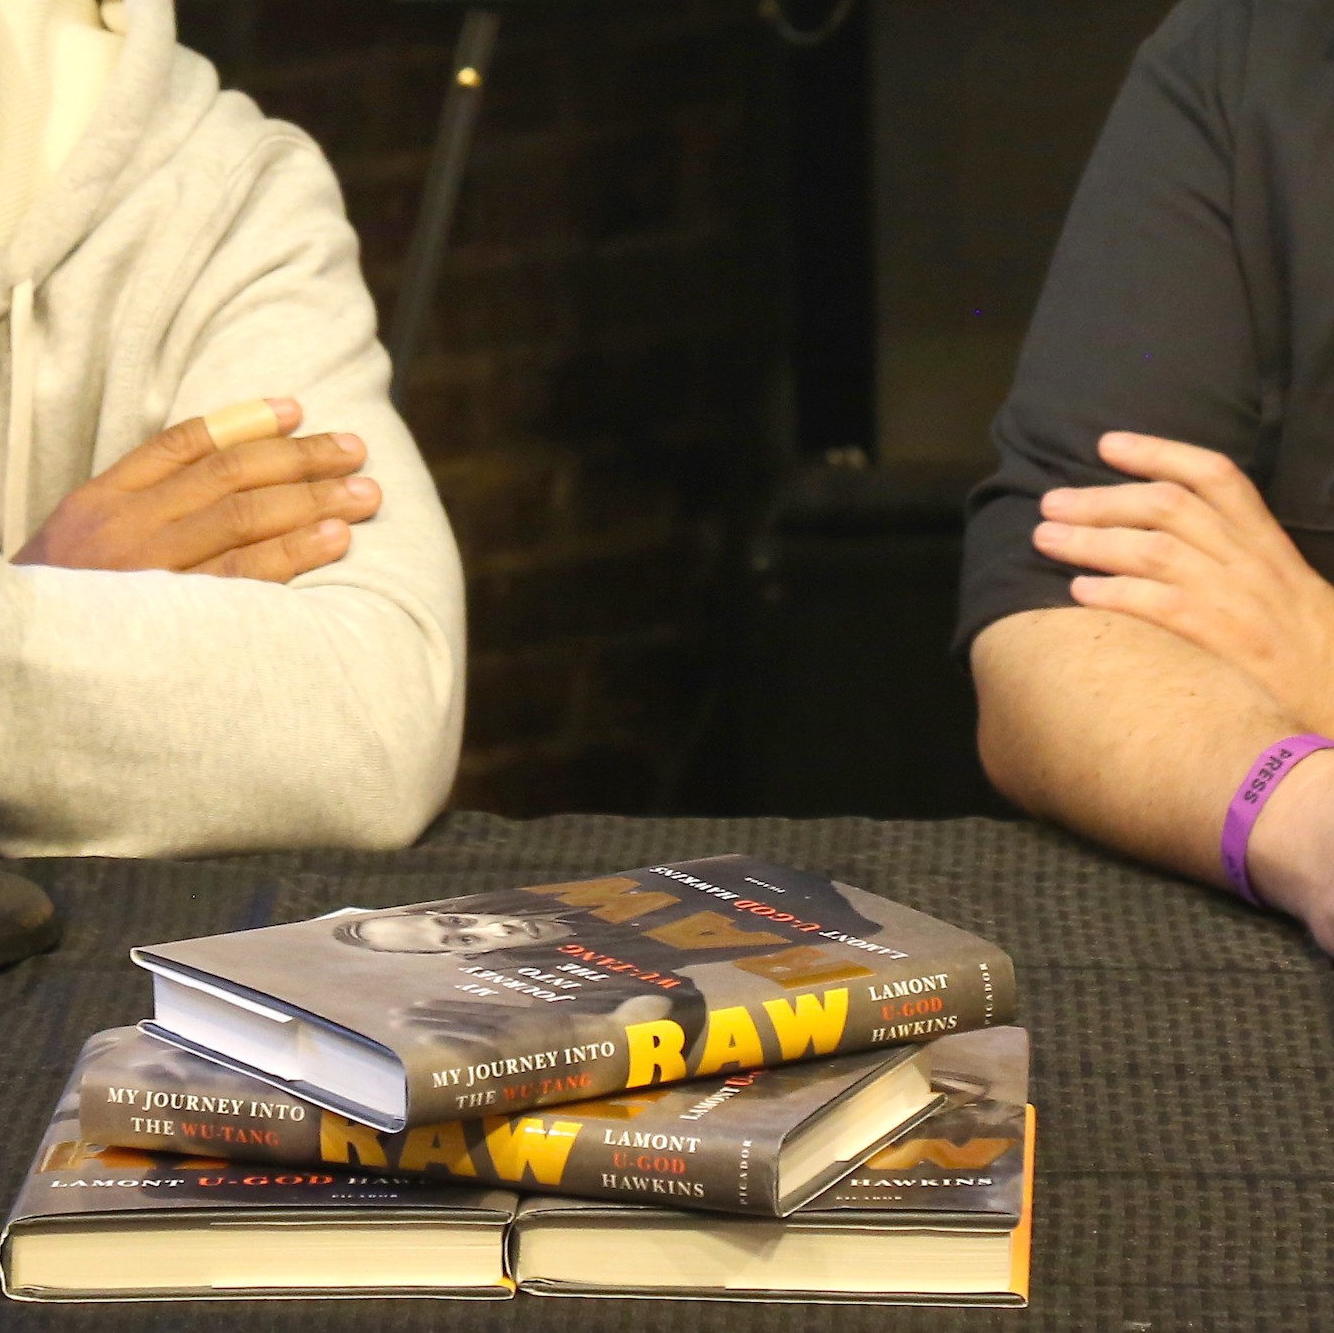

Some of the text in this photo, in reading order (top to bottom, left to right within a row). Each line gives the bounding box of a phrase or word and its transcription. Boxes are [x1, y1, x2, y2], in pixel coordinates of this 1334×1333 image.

[1244, 748, 1293, 805] PRESS
[649, 866, 740, 901] HAWKINS
[819, 930, 909, 960] LAMONT
[517, 967, 582, 989] INTO
[556, 944, 682, 989] WU-TANG
[556, 963, 610, 982] THE
[458, 965, 576, 1003] JOURNEY
[868, 973, 949, 1002] LAMONT
[881, 997, 944, 1021] U-GOD
[624, 987, 849, 1089] RAW
[870, 1015, 959, 1043] HAWKINS
[432, 1041, 616, 1089] MY JOURNEY INTO
[107, 1087, 306, 1122] MY JOURNEY INTO
[455, 1072, 594, 1109] THE WU-TANG
[130, 1117, 280, 1147] THE WU-TANG
[603, 1129, 702, 1154] LAMONT
[613, 1152, 687, 1176] U-GOD
[49, 1177, 186, 1189] LAMONT
[197, 1173, 336, 1187] U-GOD
[601, 1173, 706, 1199] HAWKINS
[849, 1177, 994, 1187] HAWKINS
